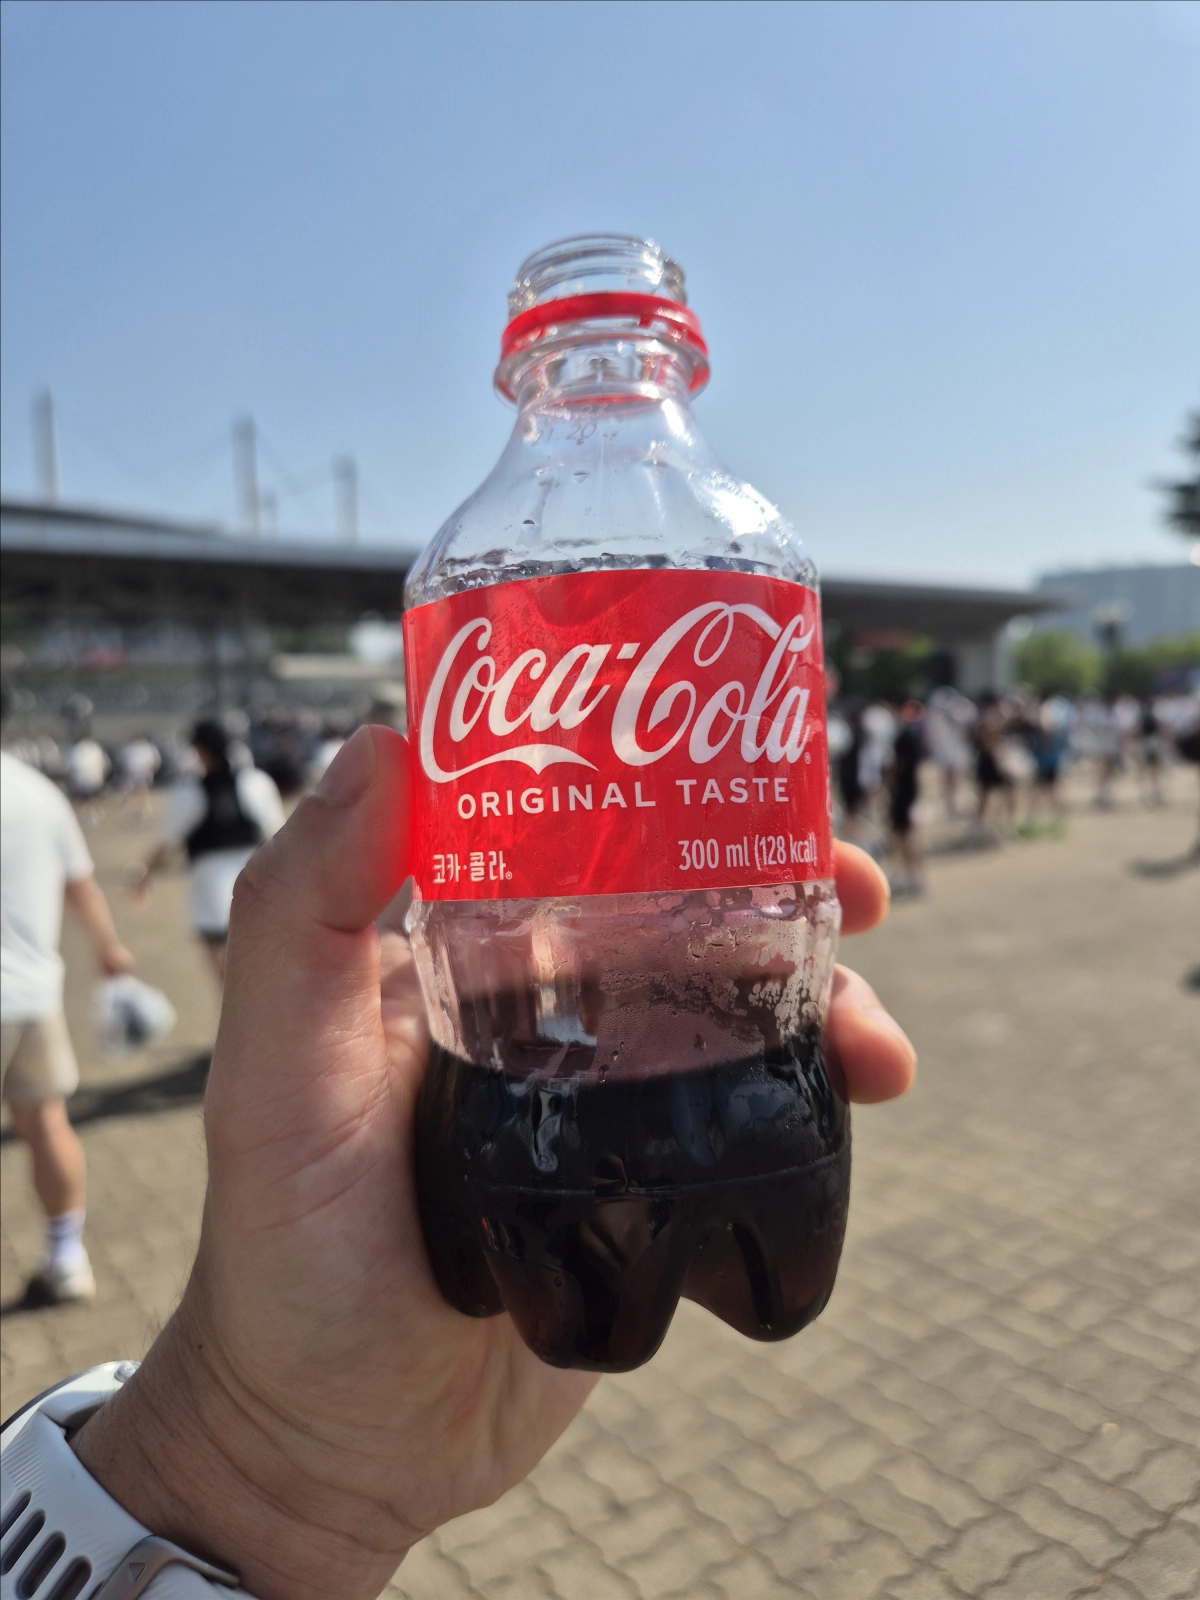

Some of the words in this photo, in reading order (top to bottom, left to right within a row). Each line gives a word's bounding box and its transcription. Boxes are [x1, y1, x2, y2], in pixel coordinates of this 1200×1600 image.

[457, 780, 657, 820] ORIGINAL
[676, 777, 790, 806] TASTE
[677, 838, 720, 871] 300
[725, 836, 751, 868] ml
[754, 834, 787, 871] (128
